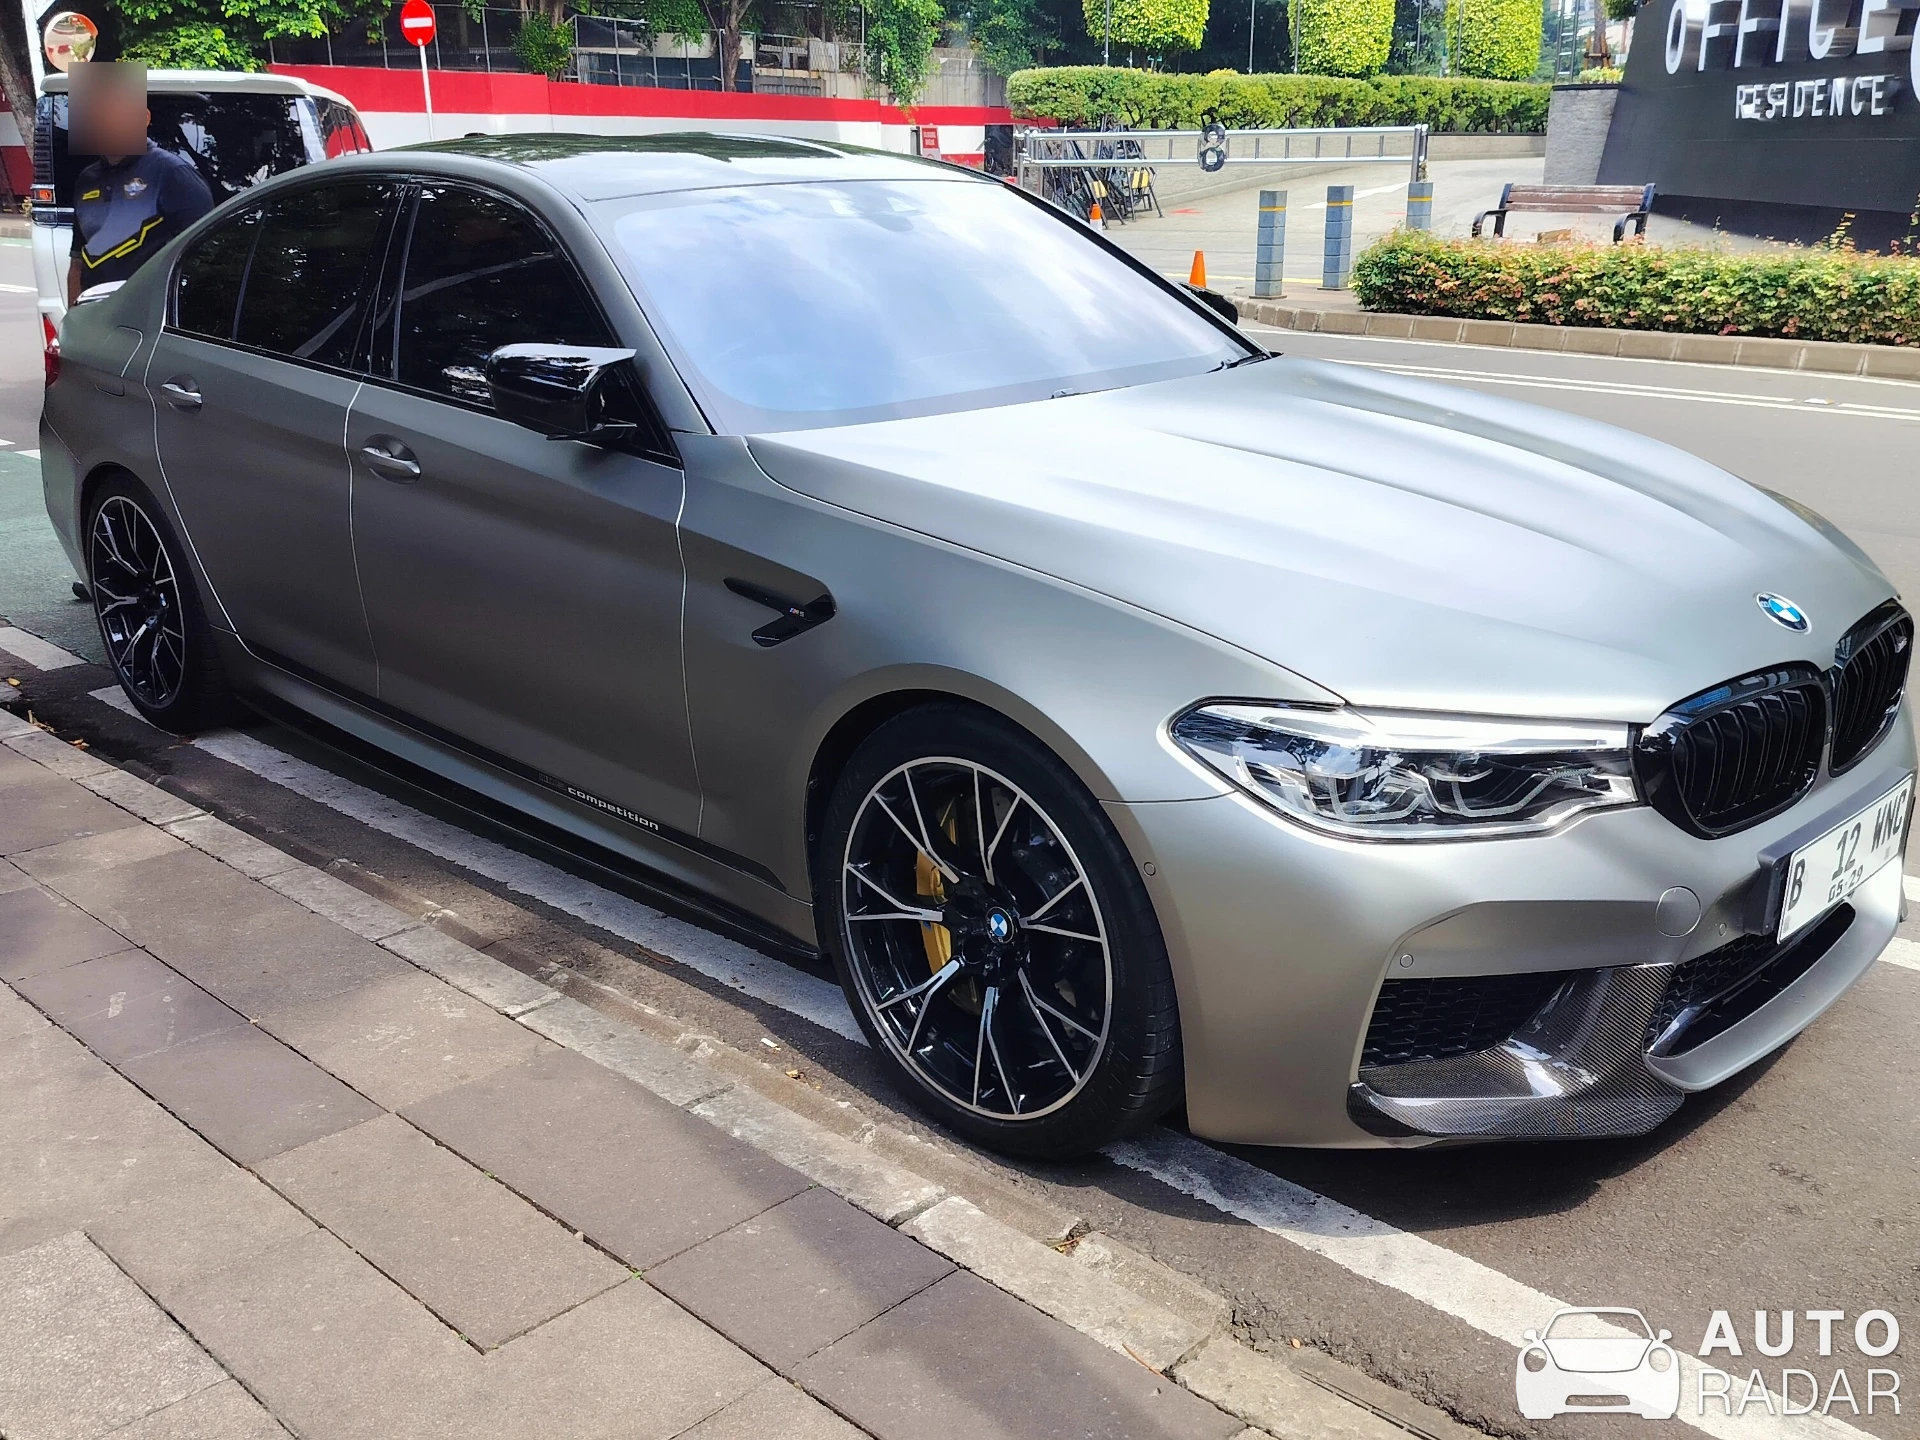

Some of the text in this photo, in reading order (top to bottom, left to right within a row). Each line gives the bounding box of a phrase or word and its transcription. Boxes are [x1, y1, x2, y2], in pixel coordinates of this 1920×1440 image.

[1665, 0, 1888, 75] OFFICE
[1735, 75, 1886, 120] RESIDENCE
[1199, 124, 1226, 172] 8
[567, 786, 660, 831] competition
[1788, 858, 1806, 911] B
[1832, 821, 1862, 881] 12
